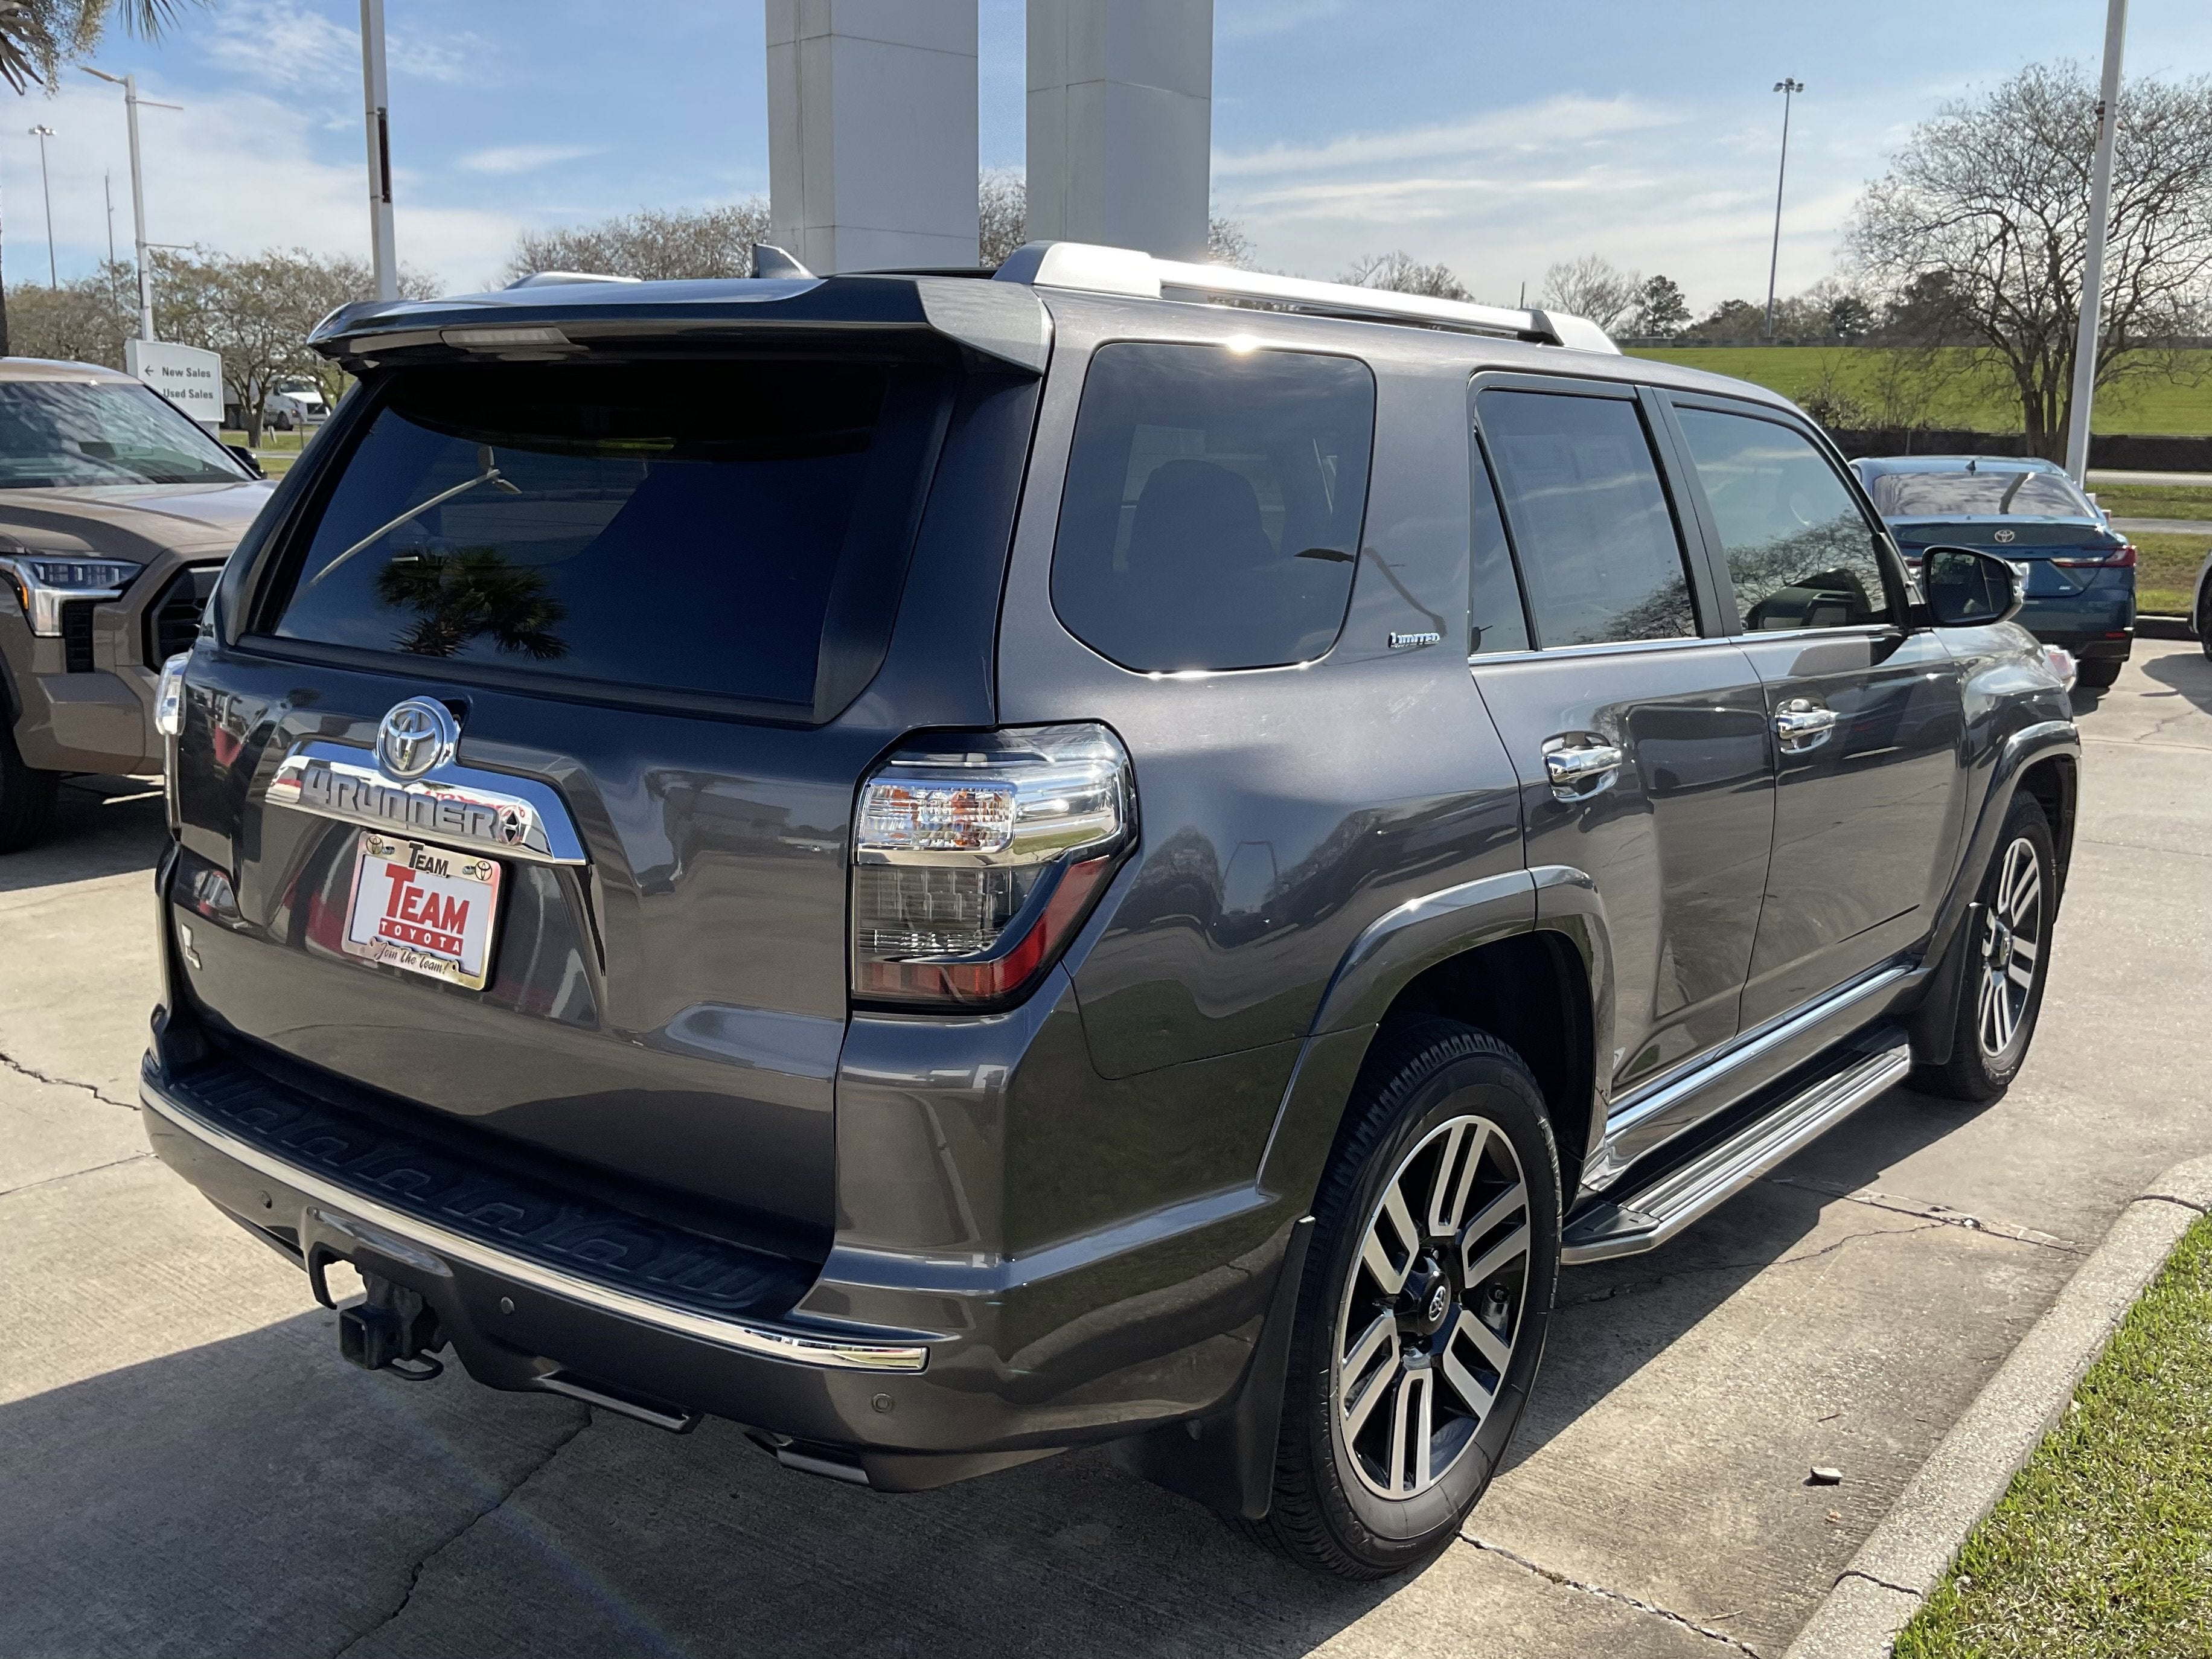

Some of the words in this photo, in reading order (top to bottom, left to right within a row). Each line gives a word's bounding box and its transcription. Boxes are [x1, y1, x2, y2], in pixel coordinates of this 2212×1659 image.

[162, 366, 184, 377] New
[186, 367, 211, 378] Sales
[163, 388, 186, 398] Used
[188, 389, 213, 399] Sales
[303, 767, 500, 839] 4RUNNER
[408, 842, 449, 877] TEAM
[385, 863, 470, 935] TEAM
[374, 942, 398, 961] Join
[381, 921, 460, 953] TOYOTA
